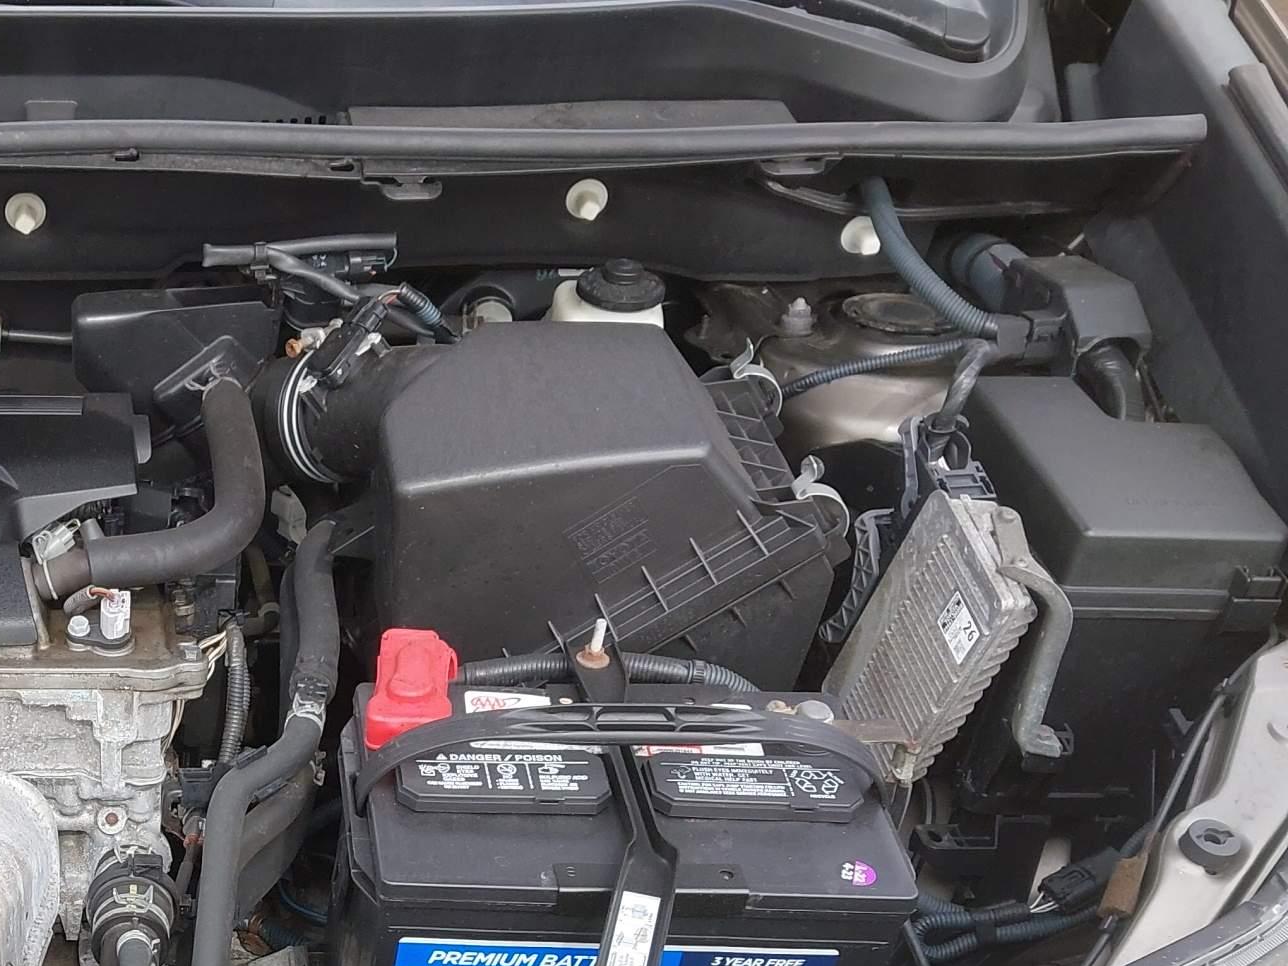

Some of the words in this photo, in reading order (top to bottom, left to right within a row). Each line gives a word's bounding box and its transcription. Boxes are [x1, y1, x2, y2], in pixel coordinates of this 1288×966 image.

[962, 620, 977, 642] 26
[504, 753, 512, 761] /
[515, 754, 562, 762] POISON
[710, 956, 724, 966] 3
[723, 957, 765, 966] YEAR
